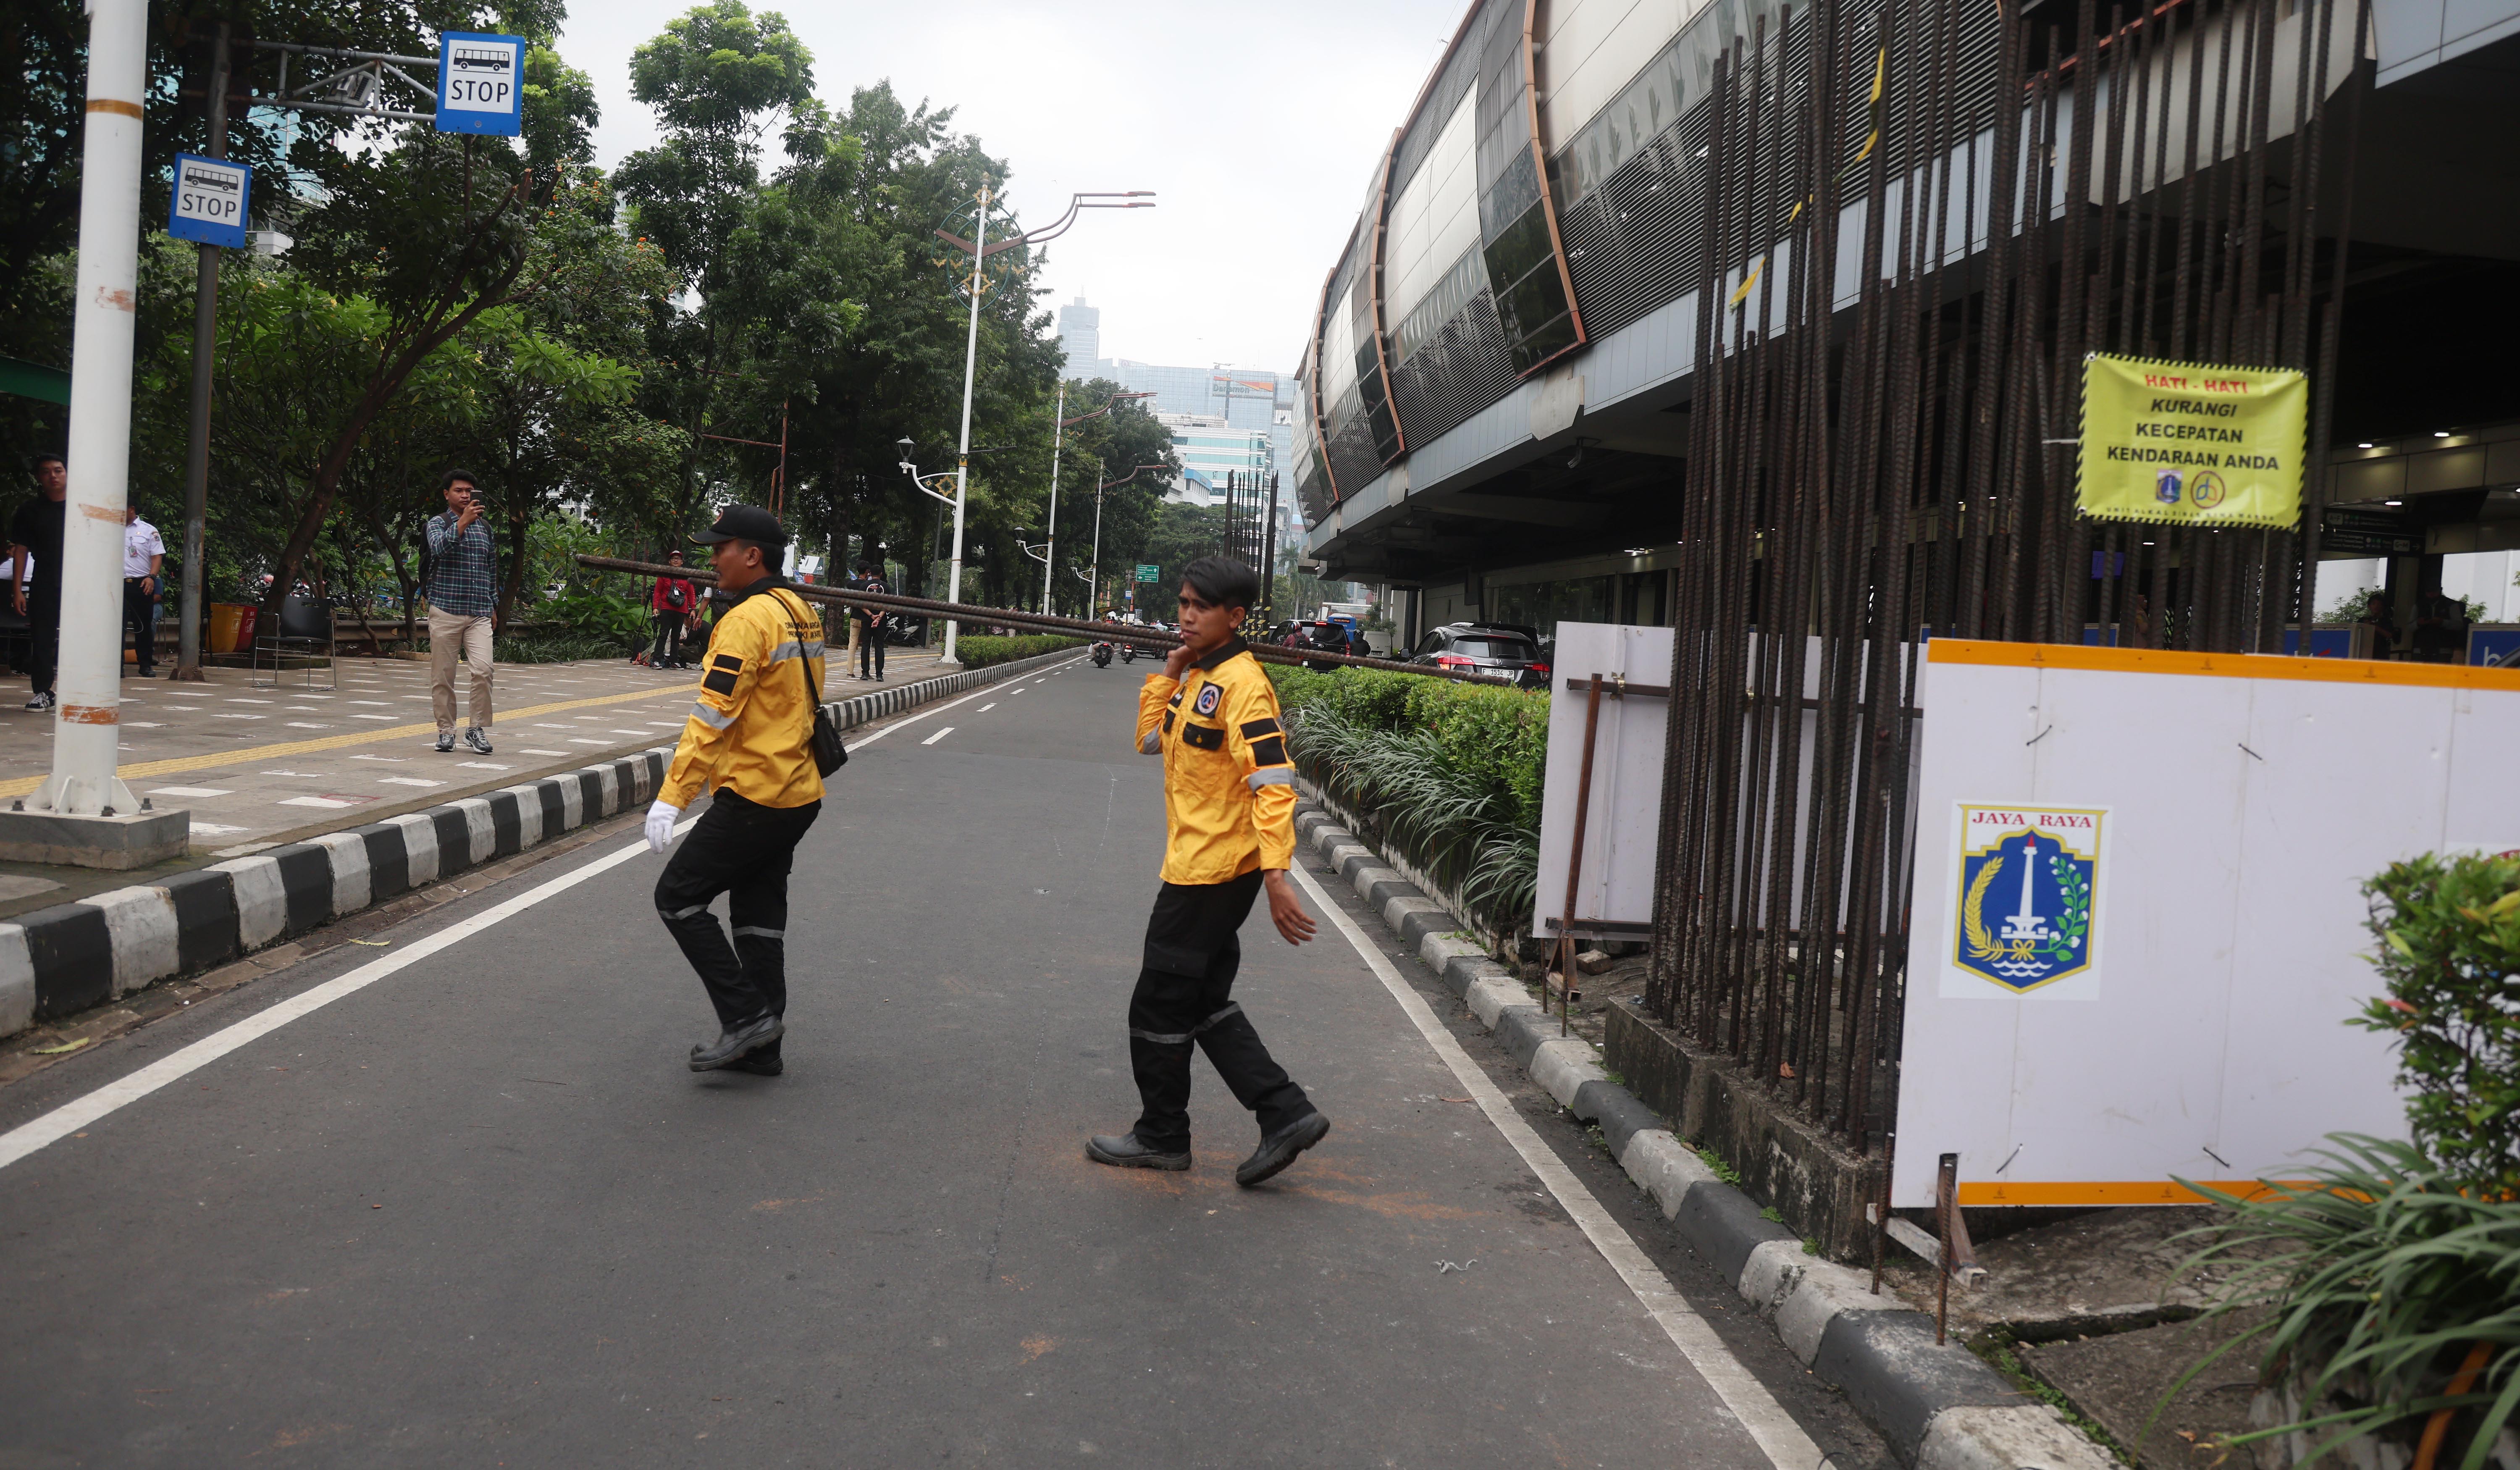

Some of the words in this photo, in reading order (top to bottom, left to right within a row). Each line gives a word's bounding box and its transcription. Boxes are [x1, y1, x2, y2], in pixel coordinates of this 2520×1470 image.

[451, 79, 509, 102] STOP
[182, 193, 236, 218] STOP
[1213, 384, 1250, 393] Danamon
[2145, 375, 2187, 389] HATI
[2205, 379, 2247, 393] HATI
[2151, 399, 2237, 417] KURANGI
[2136, 423, 2242, 443] KECEPATAN
[2108, 446, 2218, 467] KENDARAAN
[2224, 455, 2278, 470] ANDA
[1973, 812, 2025, 825] JAYA
[2039, 815, 2092, 828] RAYA
